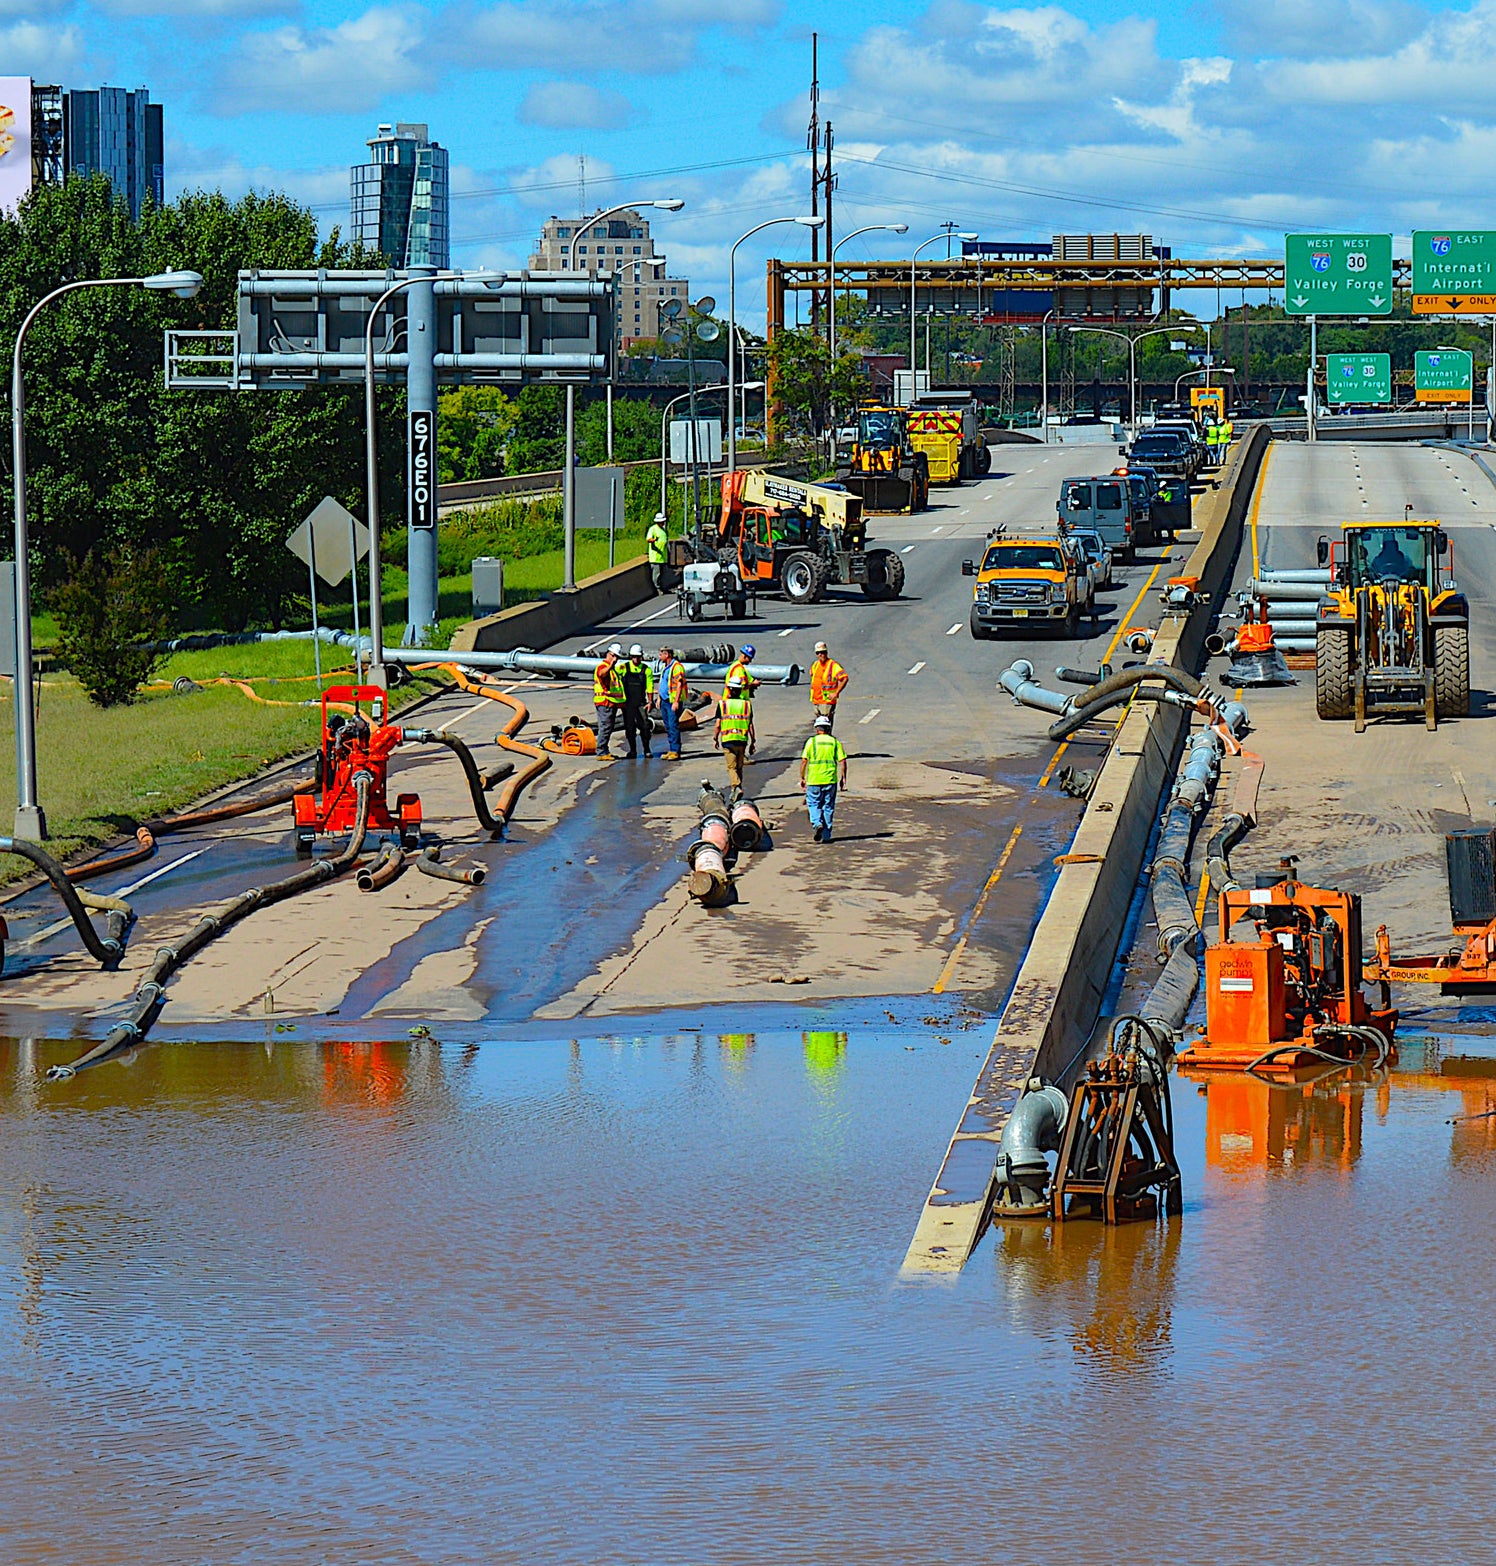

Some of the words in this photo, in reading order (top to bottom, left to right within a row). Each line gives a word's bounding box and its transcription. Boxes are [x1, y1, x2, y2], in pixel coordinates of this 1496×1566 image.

[1307, 239, 1334, 248] WEST
[1343, 239, 1370, 248] WEST
[1457, 235, 1484, 244] EAST
[1432, 241, 1449, 253] 76
[1312, 257, 1328, 269] 76
[1348, 256, 1365, 268] 30
[1423, 262, 1491, 273] Internat'l
[1293, 279, 1337, 292] Valley
[1346, 279, 1384, 292] Forge
[1432, 278, 1483, 291] Airport
[1417, 296, 1439, 305] EXIT
[1469, 296, 1496, 305] ONLY
[1332, 381, 1359, 389] Valley
[1363, 380, 1386, 389] Forge
[1423, 379, 1454, 387] Airport
[414, 417, 429, 521] 676E01
[1219, 959, 1253, 969] godwin
[1219, 969, 1253, 978] pumps
